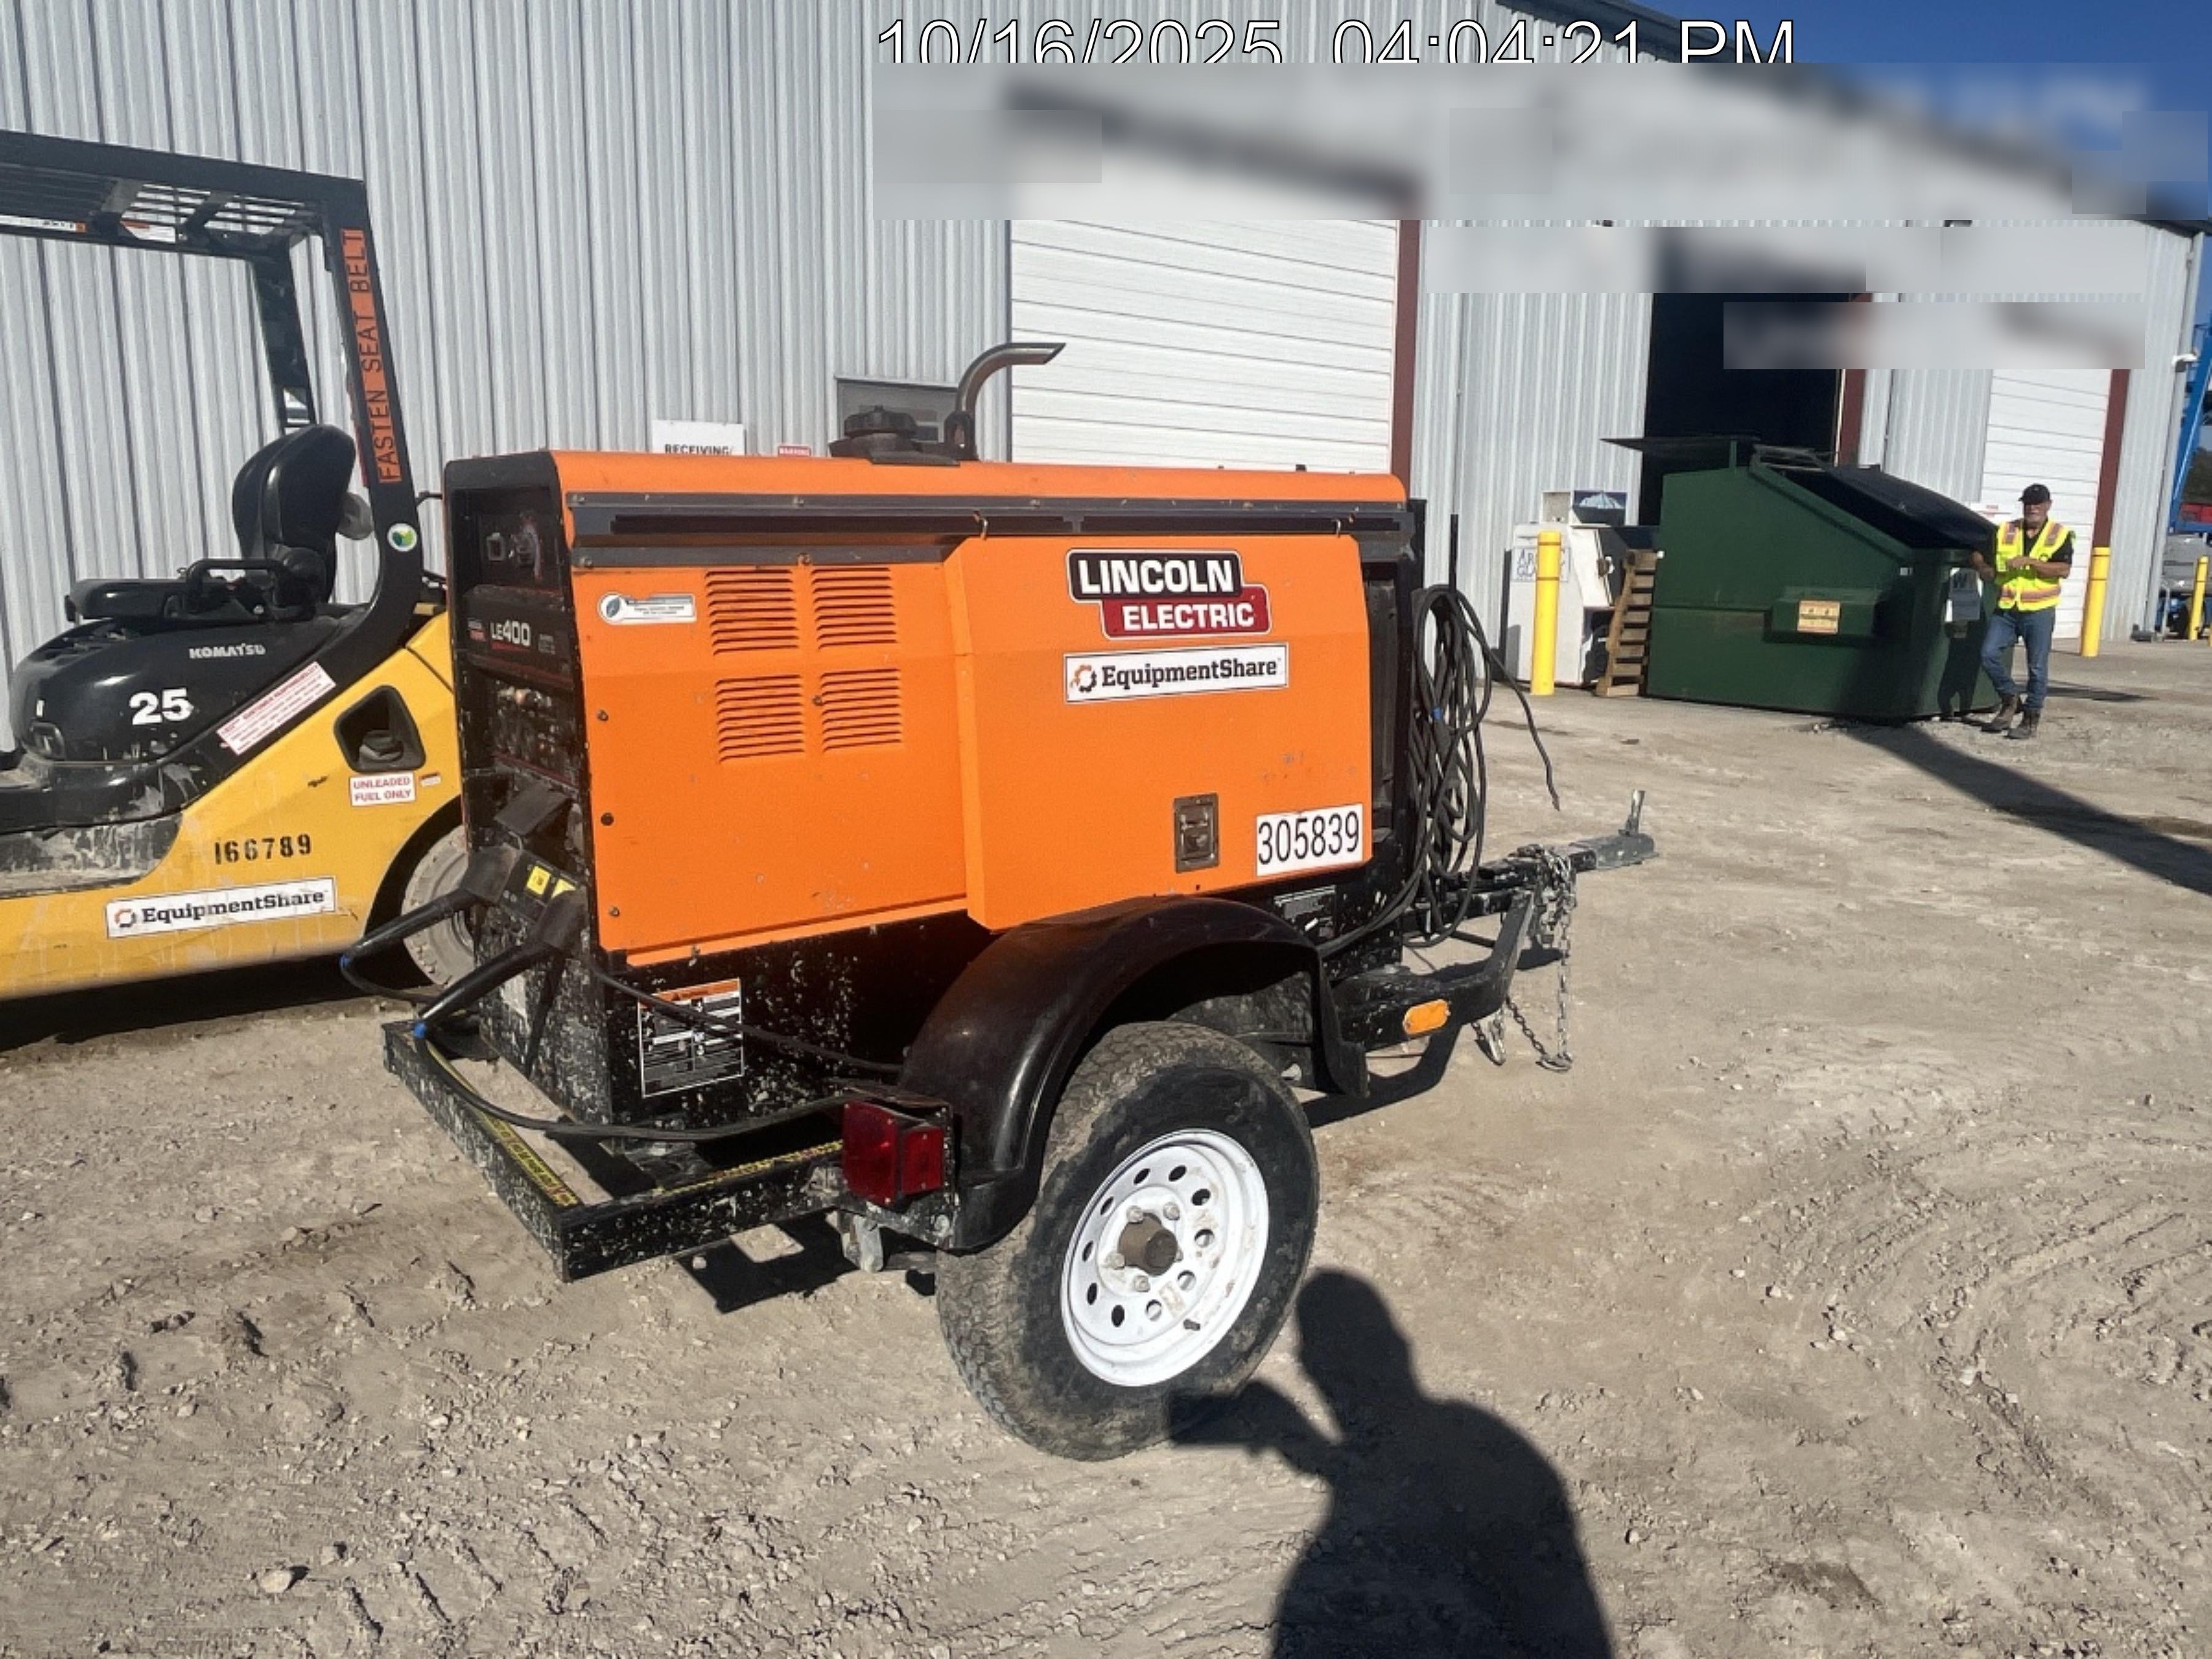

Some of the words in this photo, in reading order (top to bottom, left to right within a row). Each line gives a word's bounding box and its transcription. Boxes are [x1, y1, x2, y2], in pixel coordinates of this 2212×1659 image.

[342, 229, 369, 292] BELT
[353, 311, 380, 372] SEAT
[366, 390, 402, 480] FASTEN
[1078, 559, 1234, 594] LINCOLN
[490, 619, 531, 647] LE400
[1122, 602, 1255, 632] ELECTRIC
[189, 643, 266, 659] KOMATSU
[1101, 658, 1277, 690] EquipmentShare
[129, 688, 194, 726] 25
[353, 776, 411, 790] UNLEADED
[355, 791, 382, 802] FUEL
[384, 789, 412, 799] ONLY
[214, 834, 312, 865] 166789
[1258, 811, 1360, 865] 305839
[141, 890, 326, 924] EquipmentShare
